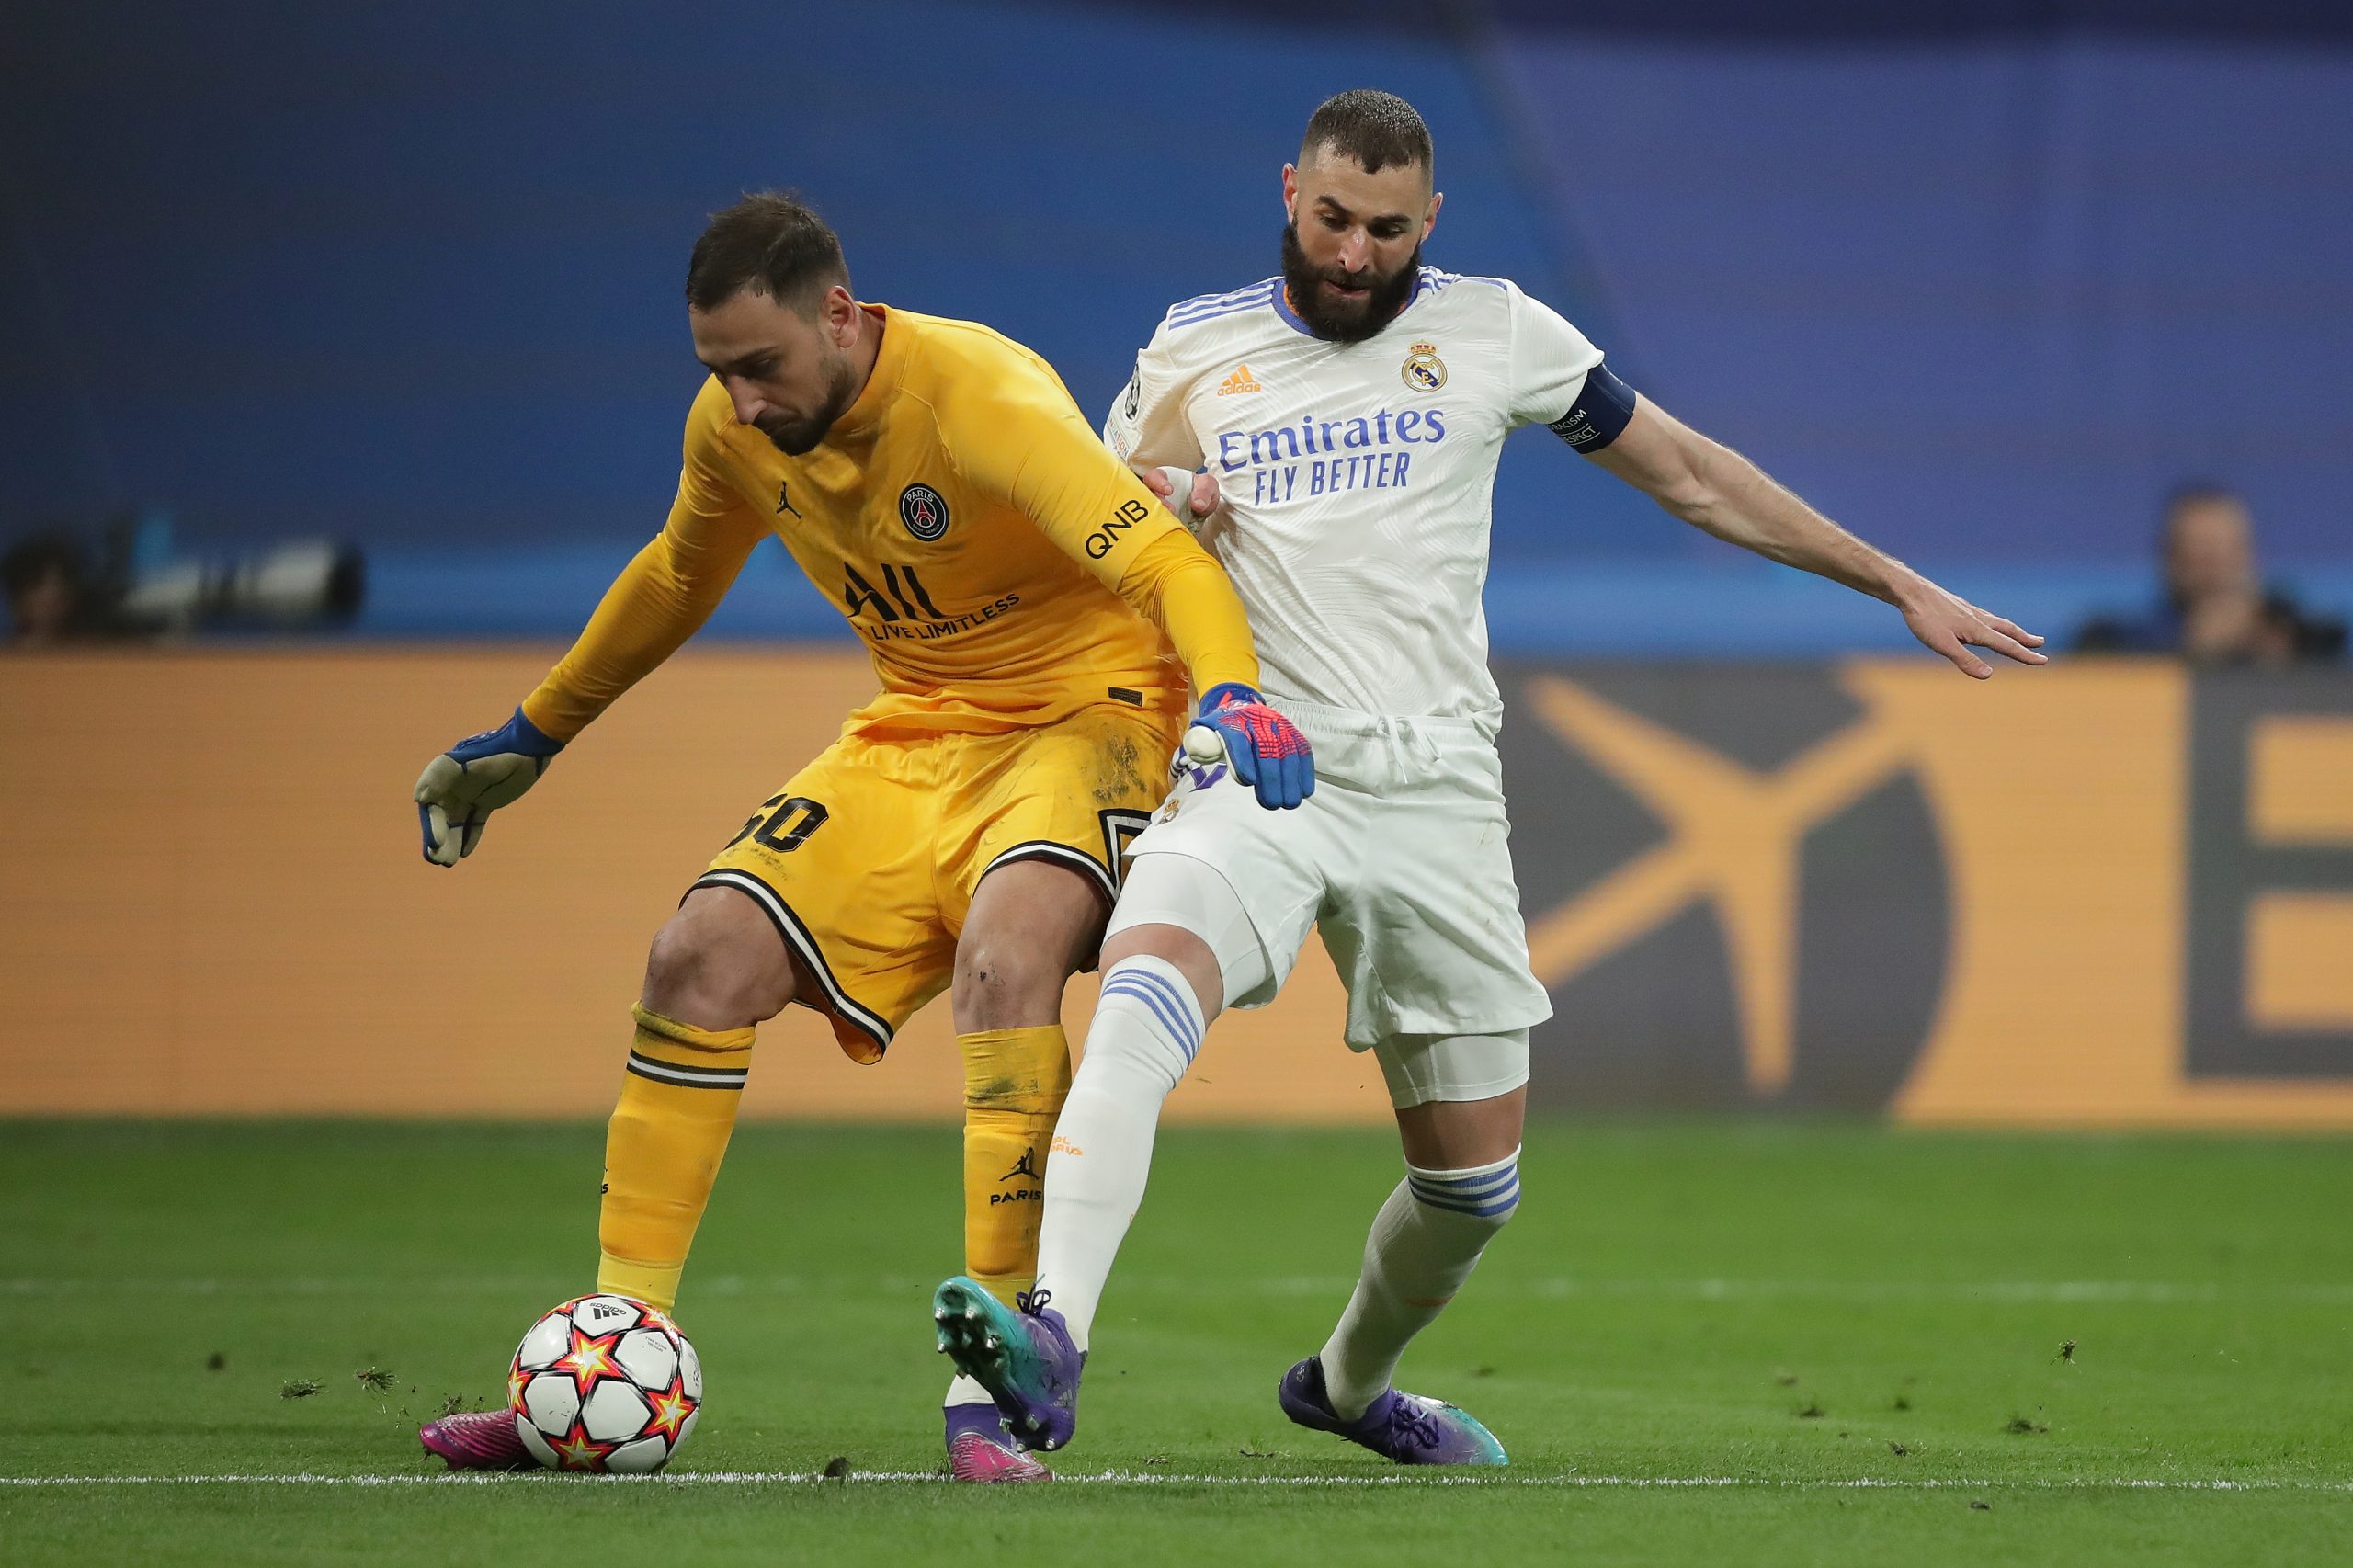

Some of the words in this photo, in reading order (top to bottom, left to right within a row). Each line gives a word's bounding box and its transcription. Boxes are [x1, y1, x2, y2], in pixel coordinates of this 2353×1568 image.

[1217, 383, 1261, 396] adidas
[1218, 407, 1446, 472] Emirates
[1563, 426, 1596, 443] ESPECT
[1255, 466, 1297, 506] FLY
[1310, 452, 1410, 495] BETTER
[906, 490, 934, 503] PARIS
[1086, 500, 1149, 559] QNB
[870, 624, 915, 641] LIVE
[915, 593, 1020, 640] LIMITLESS
[990, 1190, 1042, 1206] PARIS
[590, 1302, 627, 1315] adidas
